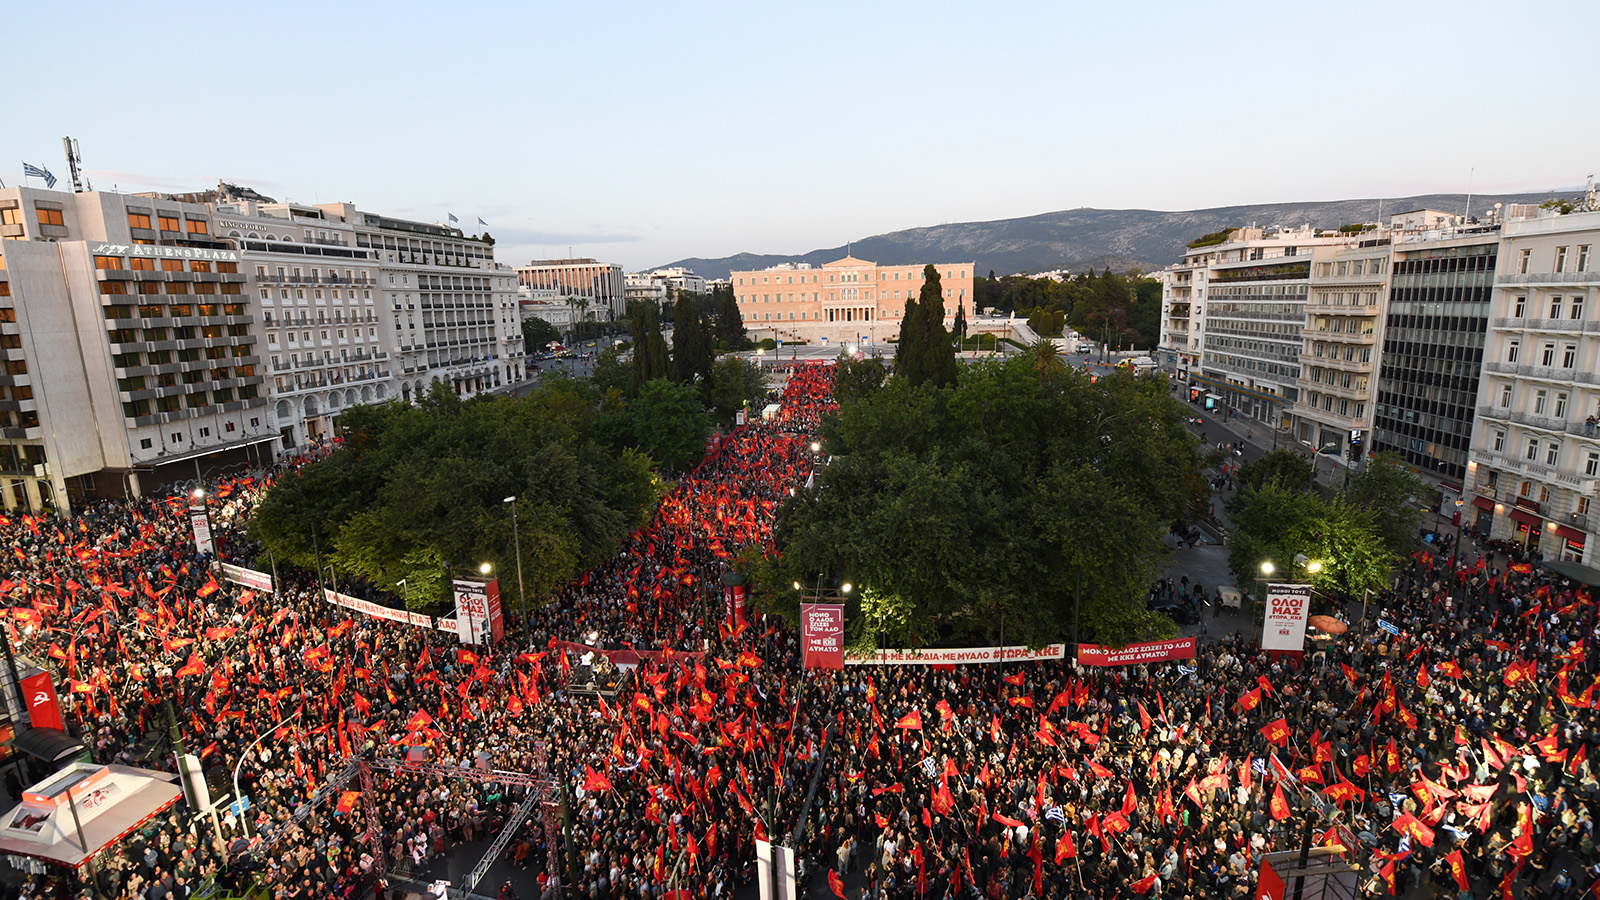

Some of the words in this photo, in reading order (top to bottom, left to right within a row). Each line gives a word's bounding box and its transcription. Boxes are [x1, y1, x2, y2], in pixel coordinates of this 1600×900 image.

[219, 220, 238, 229] KING
[239, 223, 268, 232] GEORGE
[193, 248, 236, 260] PLAZA
[1271, 598, 1303, 607] ΟΛΟΙ
[356, 601, 386, 615] ΔΥΝΑΤΟ
[1272, 607, 1301, 615] ΜΑΣ
[958, 652, 989, 660] ΜΥΑΛΟ
[1136, 650, 1169, 660] ΔΥΝΑΤΟ!
